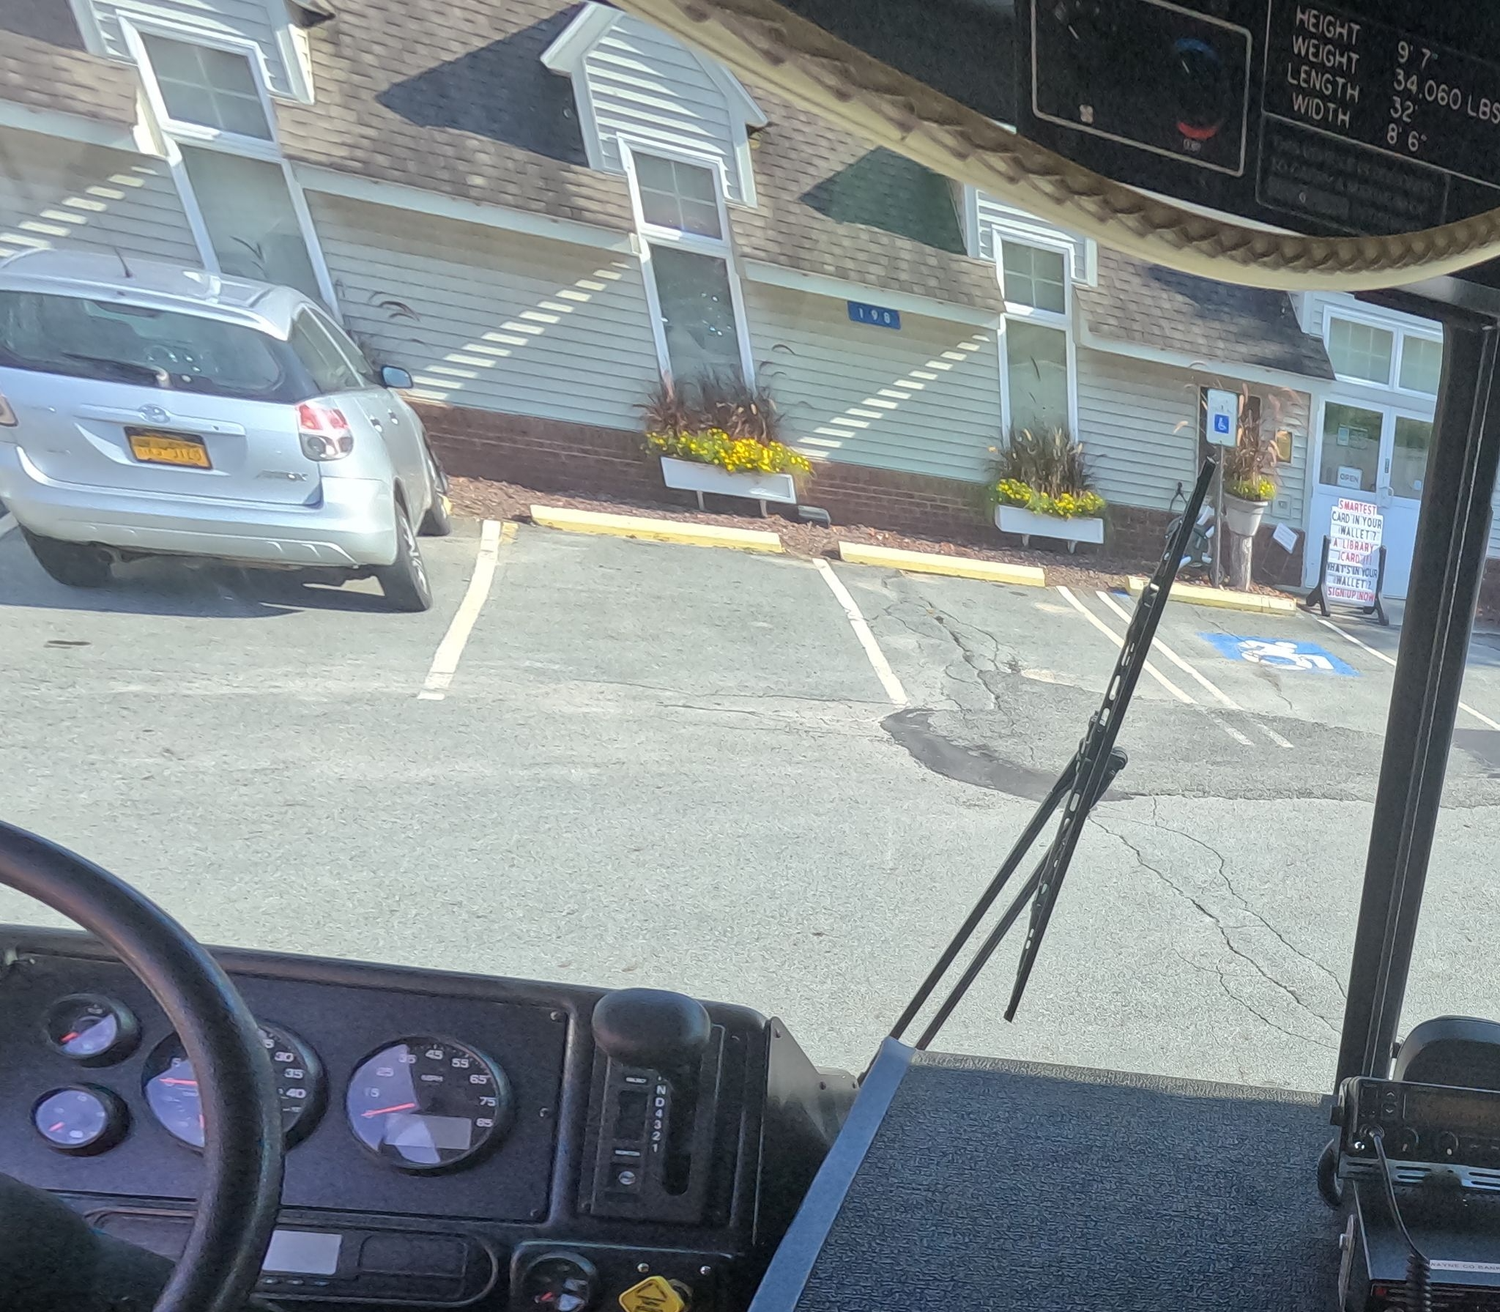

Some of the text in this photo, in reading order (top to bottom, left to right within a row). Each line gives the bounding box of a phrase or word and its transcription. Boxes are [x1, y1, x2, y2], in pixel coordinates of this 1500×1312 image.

[1296, 6, 1361, 45] HEIGHT
[1292, 35, 1360, 75] WEIGHT
[1286, 62, 1360, 104] LENGTH
[1292, 91, 1350, 130] WIDTH
[859, 307, 891, 324] 198
[1340, 472, 1360, 484] OPEN
[1339, 499, 1377, 516] SMARTEST
[1331, 510, 1383, 530] CARD IN YOUR
[1333, 538, 1374, 553] A LIBRARY
[1340, 551, 1360, 564] CARD
[1352, 566, 1360, 576] IN
[1362, 567, 1378, 578] YOUR
[1327, 586, 1375, 602] SIGN UP NOW
[274, 1052, 295, 1063] 30
[425, 1050, 443, 1060] 45
[452, 1058, 469, 1069] 55
[284, 1069, 304, 1079] 35
[470, 1074, 488, 1085] 65
[286, 1088, 307, 1099] 40
[656, 1085, 667, 1095] N
[479, 1096, 497, 1107] 75
[654, 1097, 665, 1107] D
[655, 1109, 663, 1118] 4
[654, 1120, 662, 1129] 3
[652, 1131, 660, 1141] 2
[652, 1143, 658, 1153] 1
